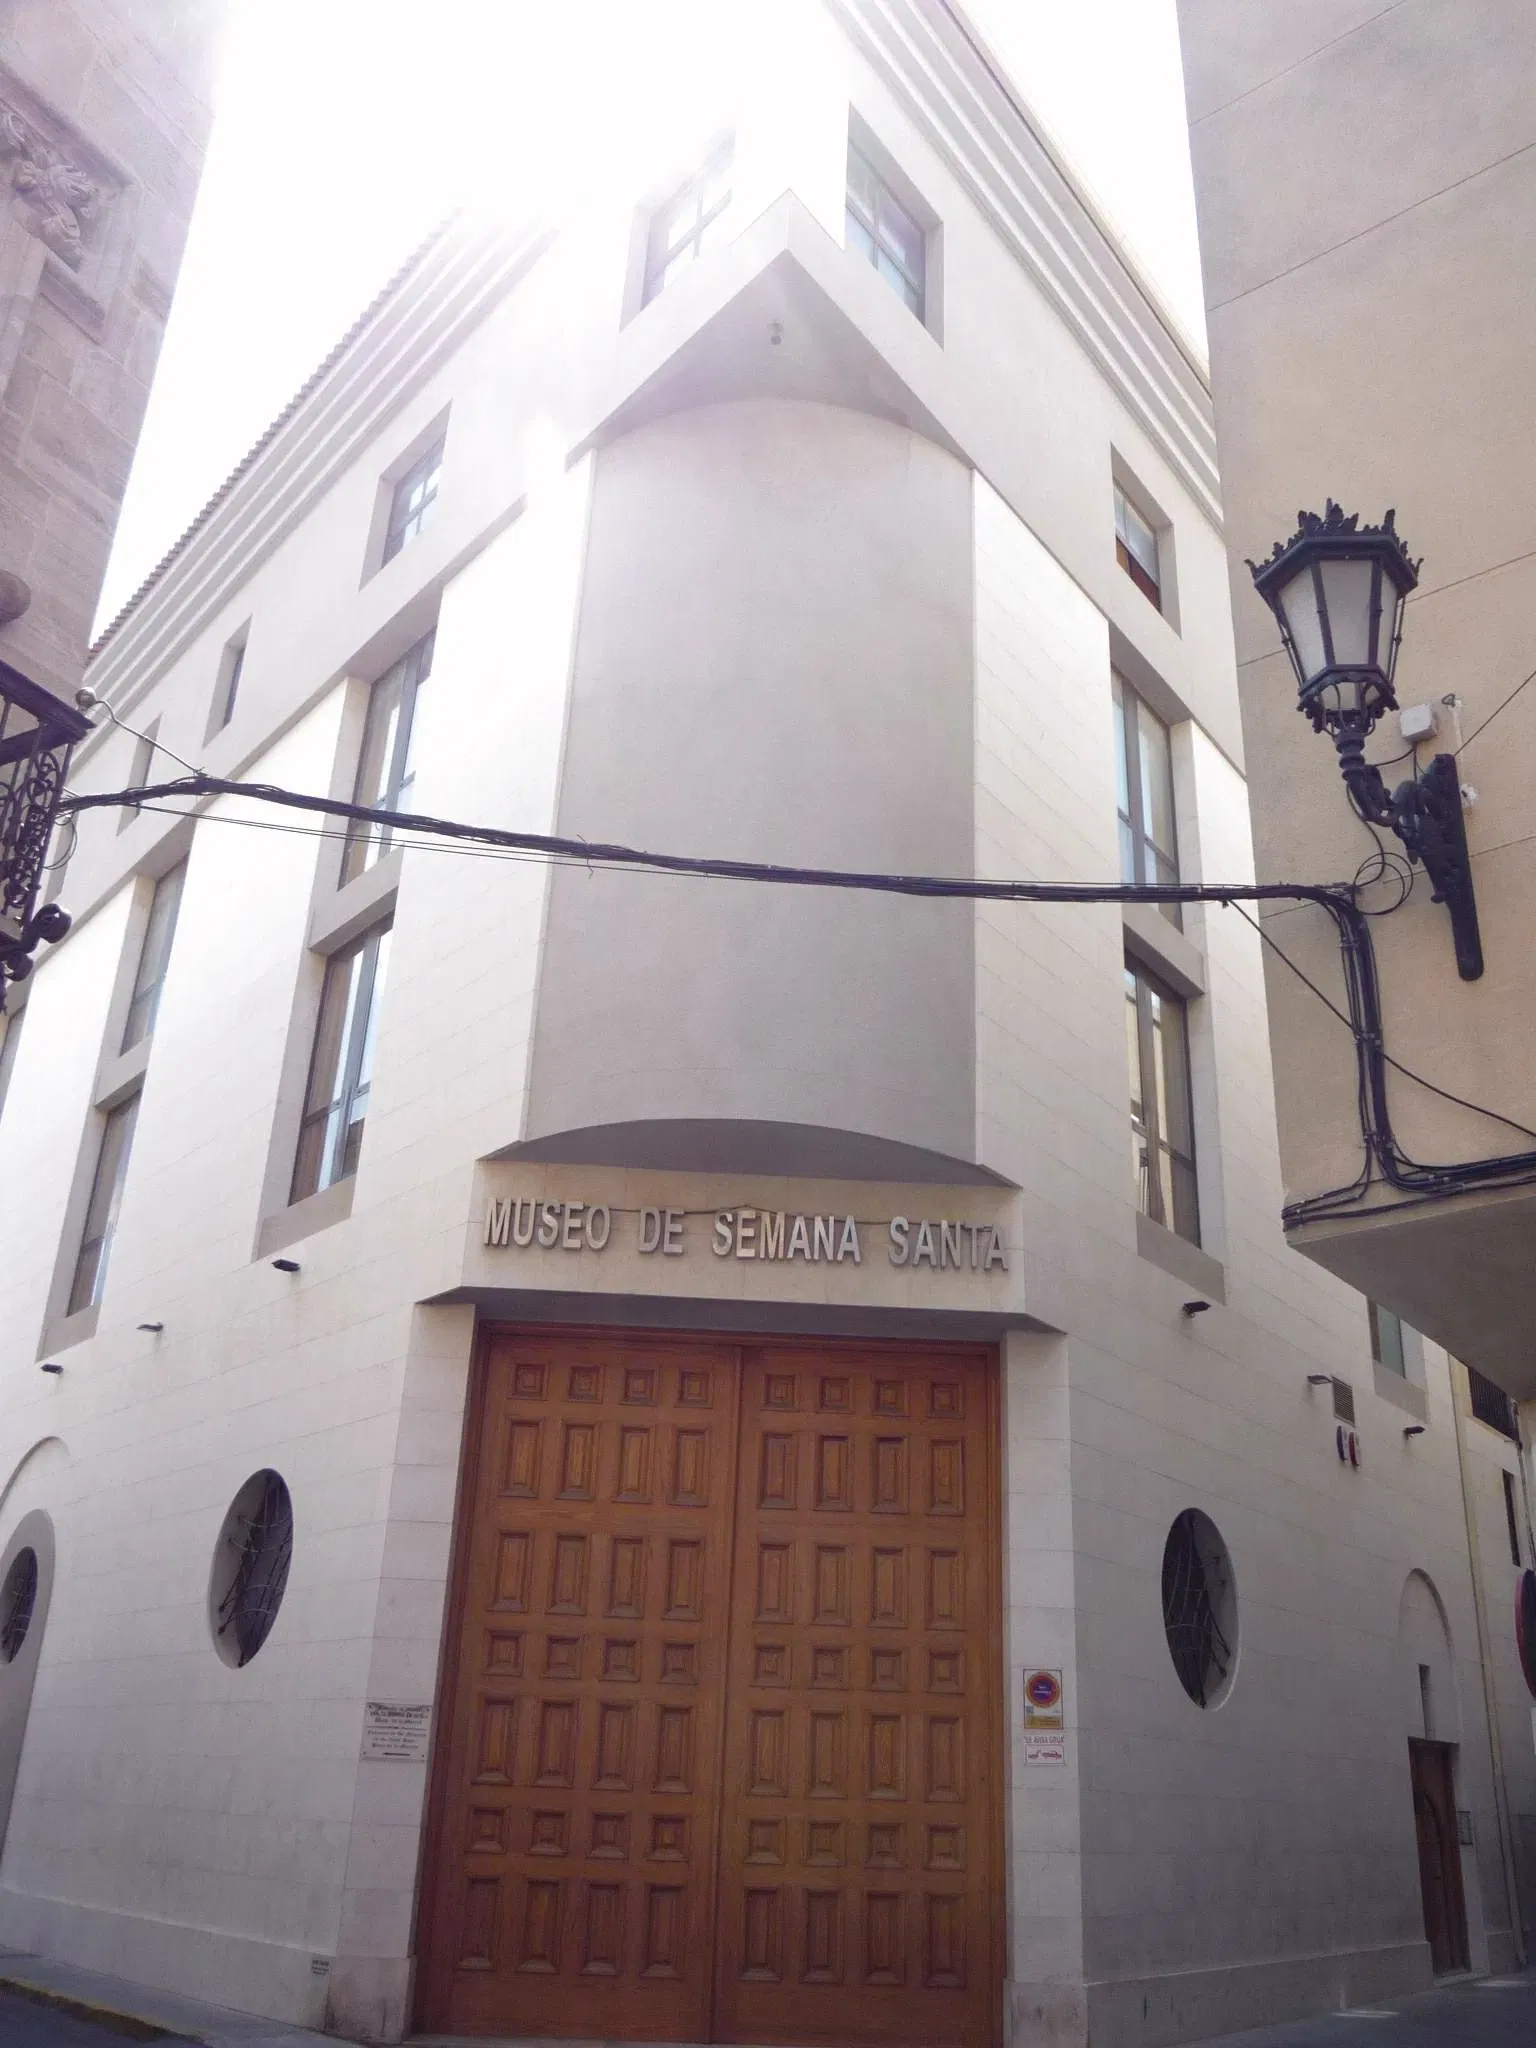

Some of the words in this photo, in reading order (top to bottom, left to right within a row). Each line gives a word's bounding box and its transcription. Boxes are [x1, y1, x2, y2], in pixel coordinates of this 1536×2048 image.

[483, 1196, 611, 1251] MUSEO
[637, 1206, 686, 1256] DE
[711, 1210, 861, 1264] SEMANA
[888, 1216, 1009, 1272] SANTA
